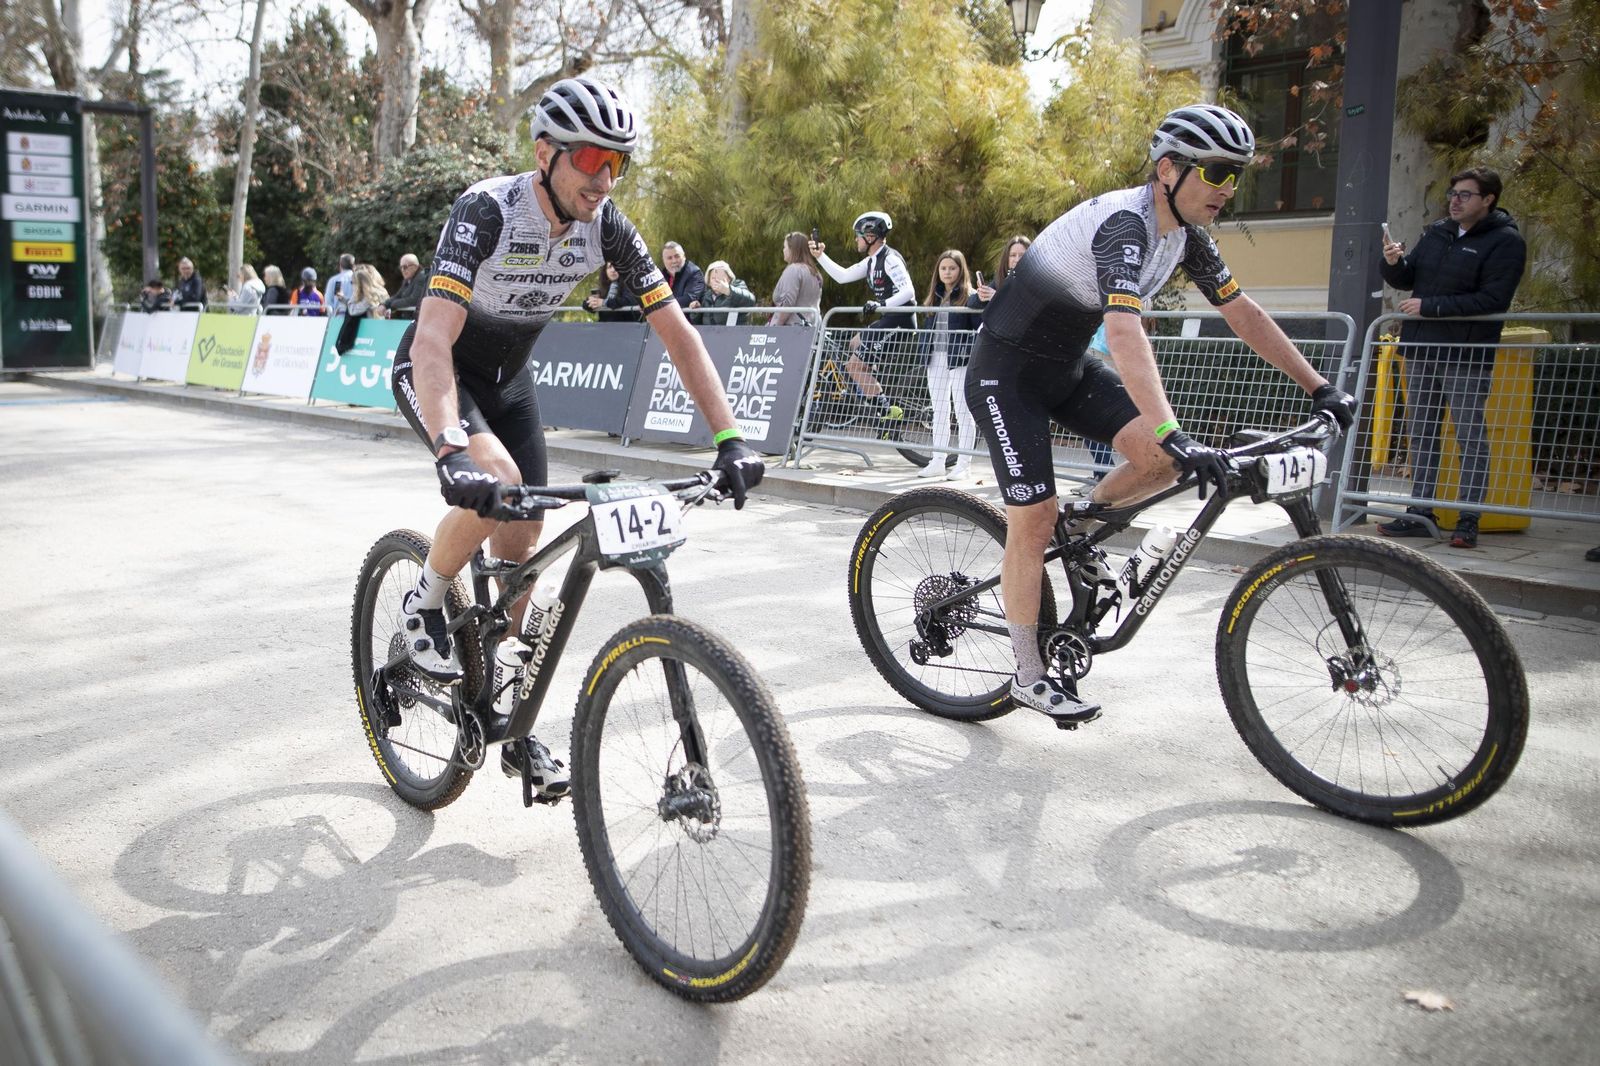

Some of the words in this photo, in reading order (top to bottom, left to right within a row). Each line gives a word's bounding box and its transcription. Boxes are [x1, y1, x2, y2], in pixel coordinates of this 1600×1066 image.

[15, 203, 69, 213] GARMIN
[509, 242, 540, 255] 226ERS
[439, 260, 472, 282] 226ERS
[493, 273, 583, 285] cannondale
[29, 285, 62, 298] GOBIK
[733, 347, 784, 366] Andalucía
[726, 365, 783, 396] BIKE
[648, 388, 695, 414] RACE
[650, 416, 686, 428] GARMIN
[986, 395, 1022, 477] cannondale
[1280, 456, 1315, 486] 14-1
[610, 501, 671, 543] 14-2
[855, 525, 877, 570] PIRELLI
[1135, 527, 1202, 616] cannondale
[1232, 564, 1283, 618] SCORPION
[1257, 577, 1281, 600] SISLENT
[520, 598, 566, 700] cannondale
[602, 636, 646, 670] PIRELLI
[363, 715, 387, 767] PIRELLI
[1428, 770, 1483, 814] PIRELLI
